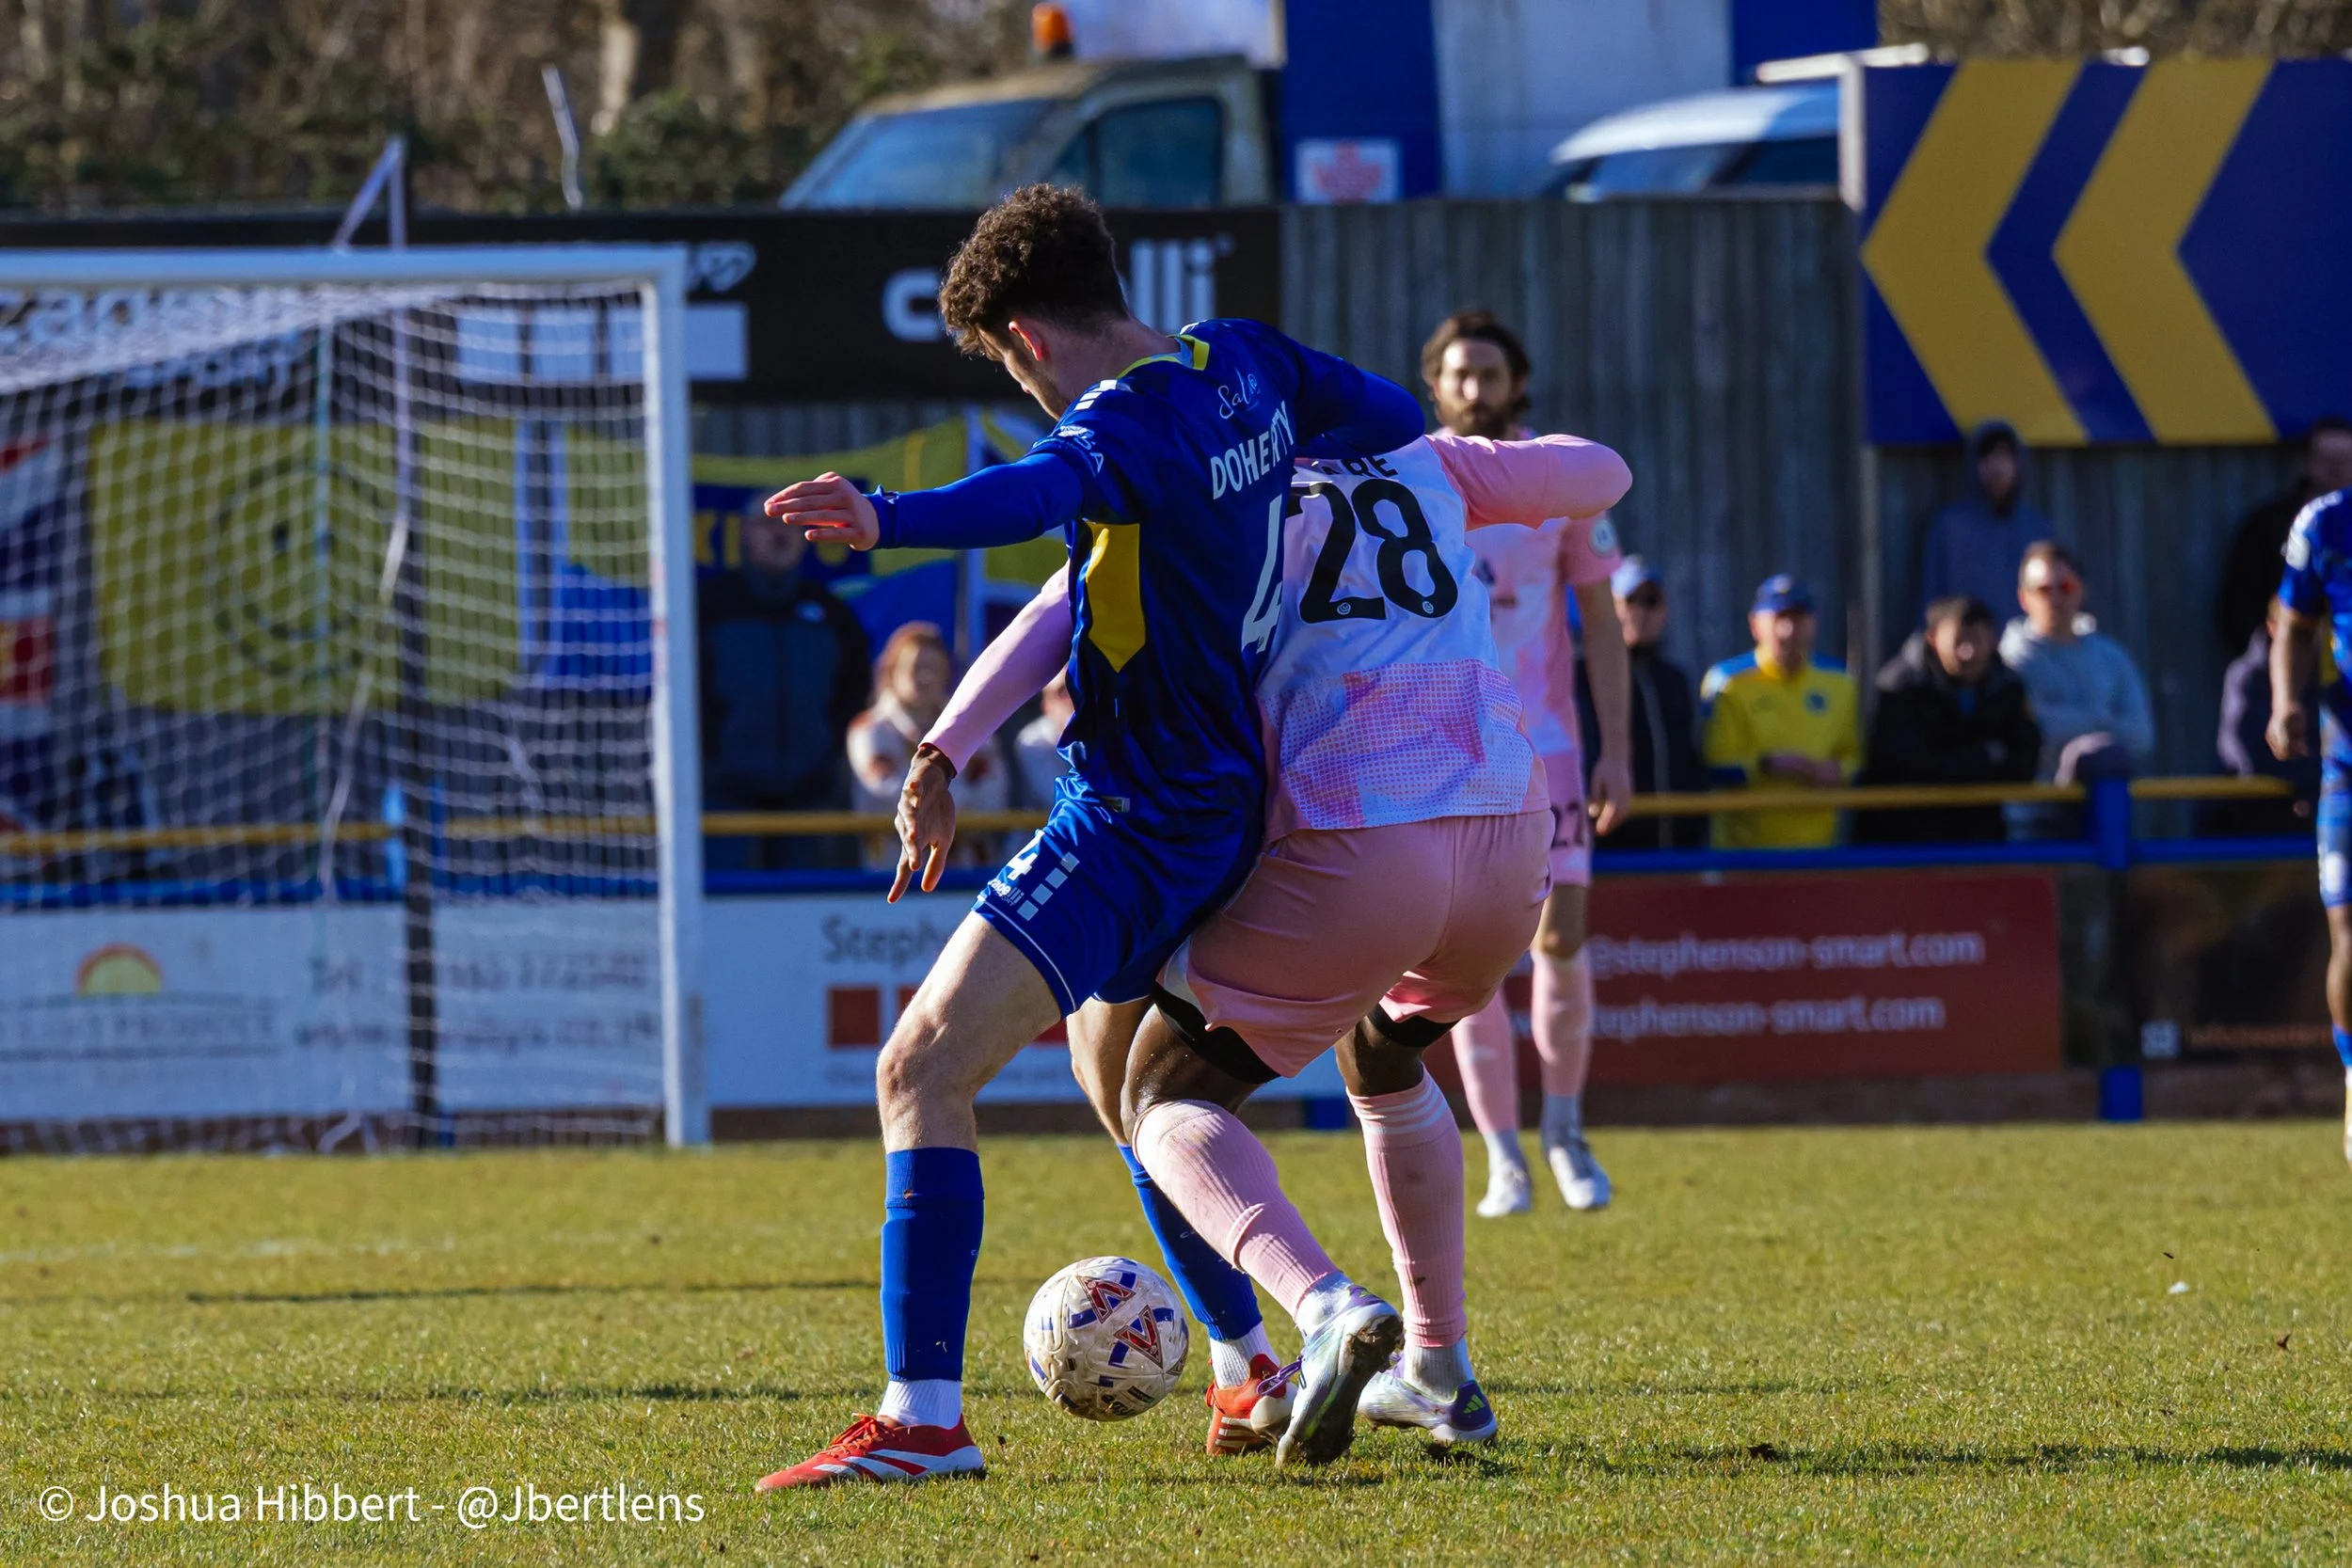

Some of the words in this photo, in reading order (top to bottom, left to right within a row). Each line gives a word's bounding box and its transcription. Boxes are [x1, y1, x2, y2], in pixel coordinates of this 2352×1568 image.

[1210, 400, 1295, 500] DOHERTY
[1241, 494, 1282, 655] 4
[1285, 481, 1458, 625] 28
[1007, 830, 1045, 880] 4
[821, 912, 945, 972] Steph
[1511, 931, 1985, 978] @stephenson-smart.com
